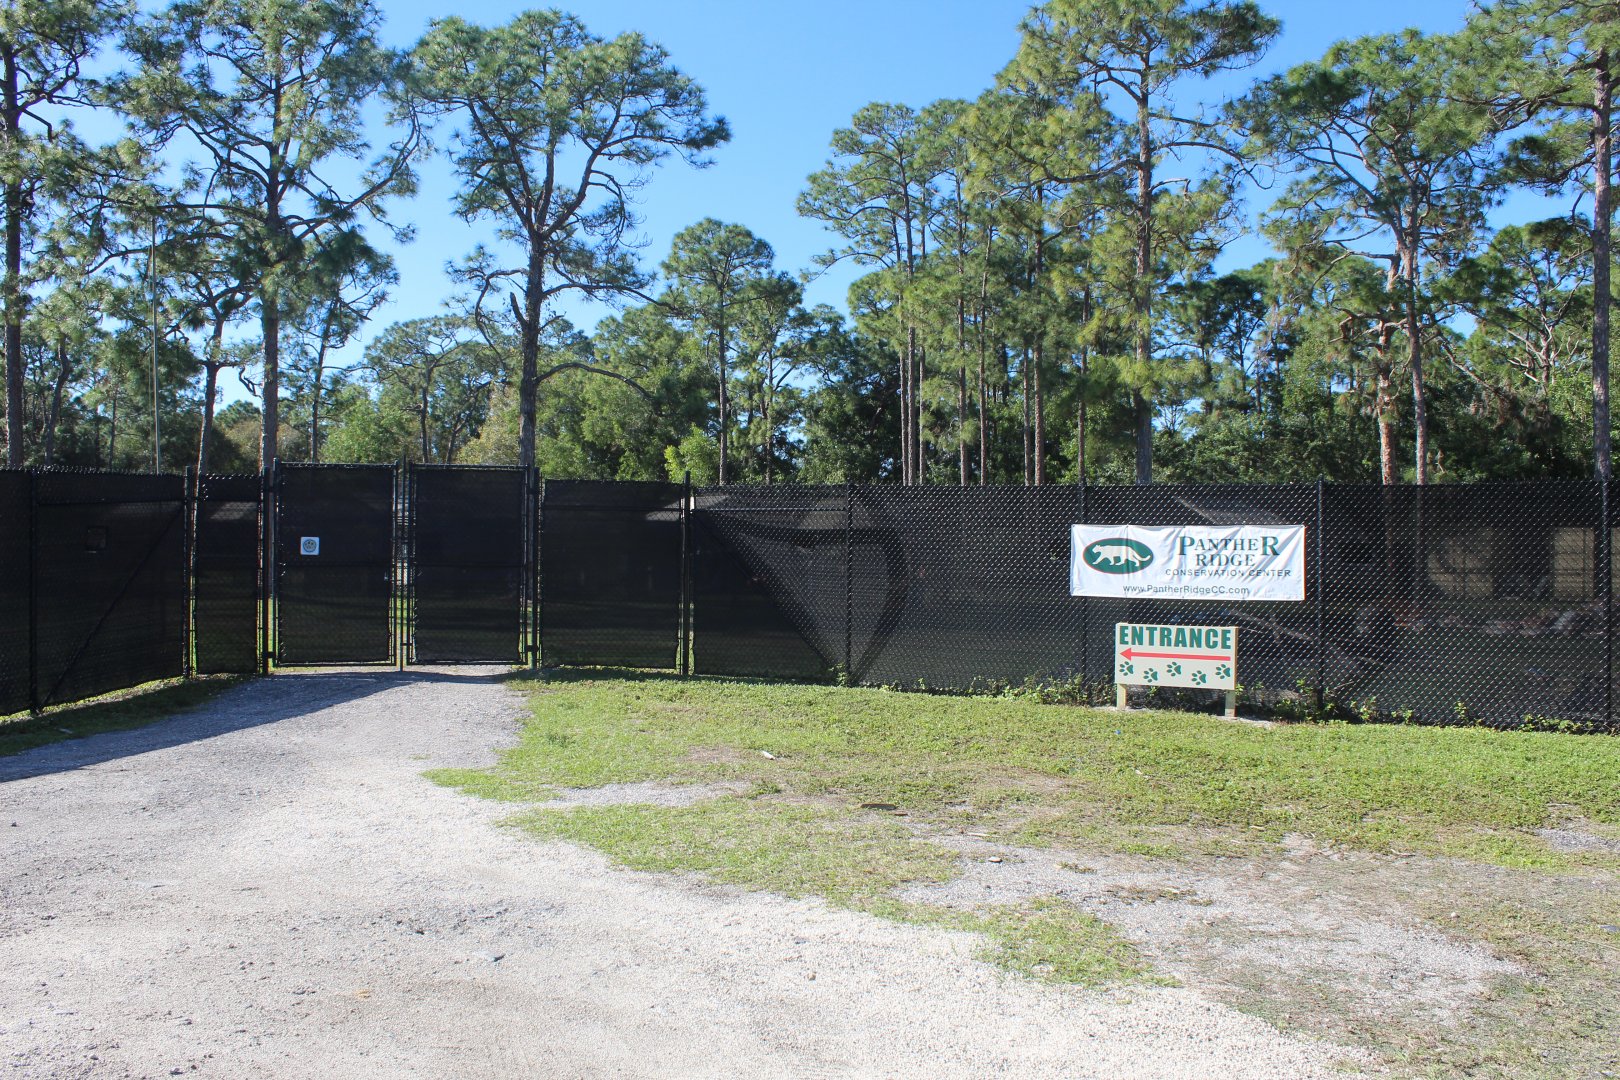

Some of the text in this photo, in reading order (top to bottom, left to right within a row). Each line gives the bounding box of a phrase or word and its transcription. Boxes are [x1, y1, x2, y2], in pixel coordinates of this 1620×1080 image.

[1178, 535, 1280, 556] PANTHER
[1195, 553, 1256, 567] RIDGE
[1165, 569, 1291, 577] CONSERVATION CENTER
[1122, 584, 1249, 595] www.PantherRidgeCC.com
[1119, 625, 1232, 650] ENTRANCE
